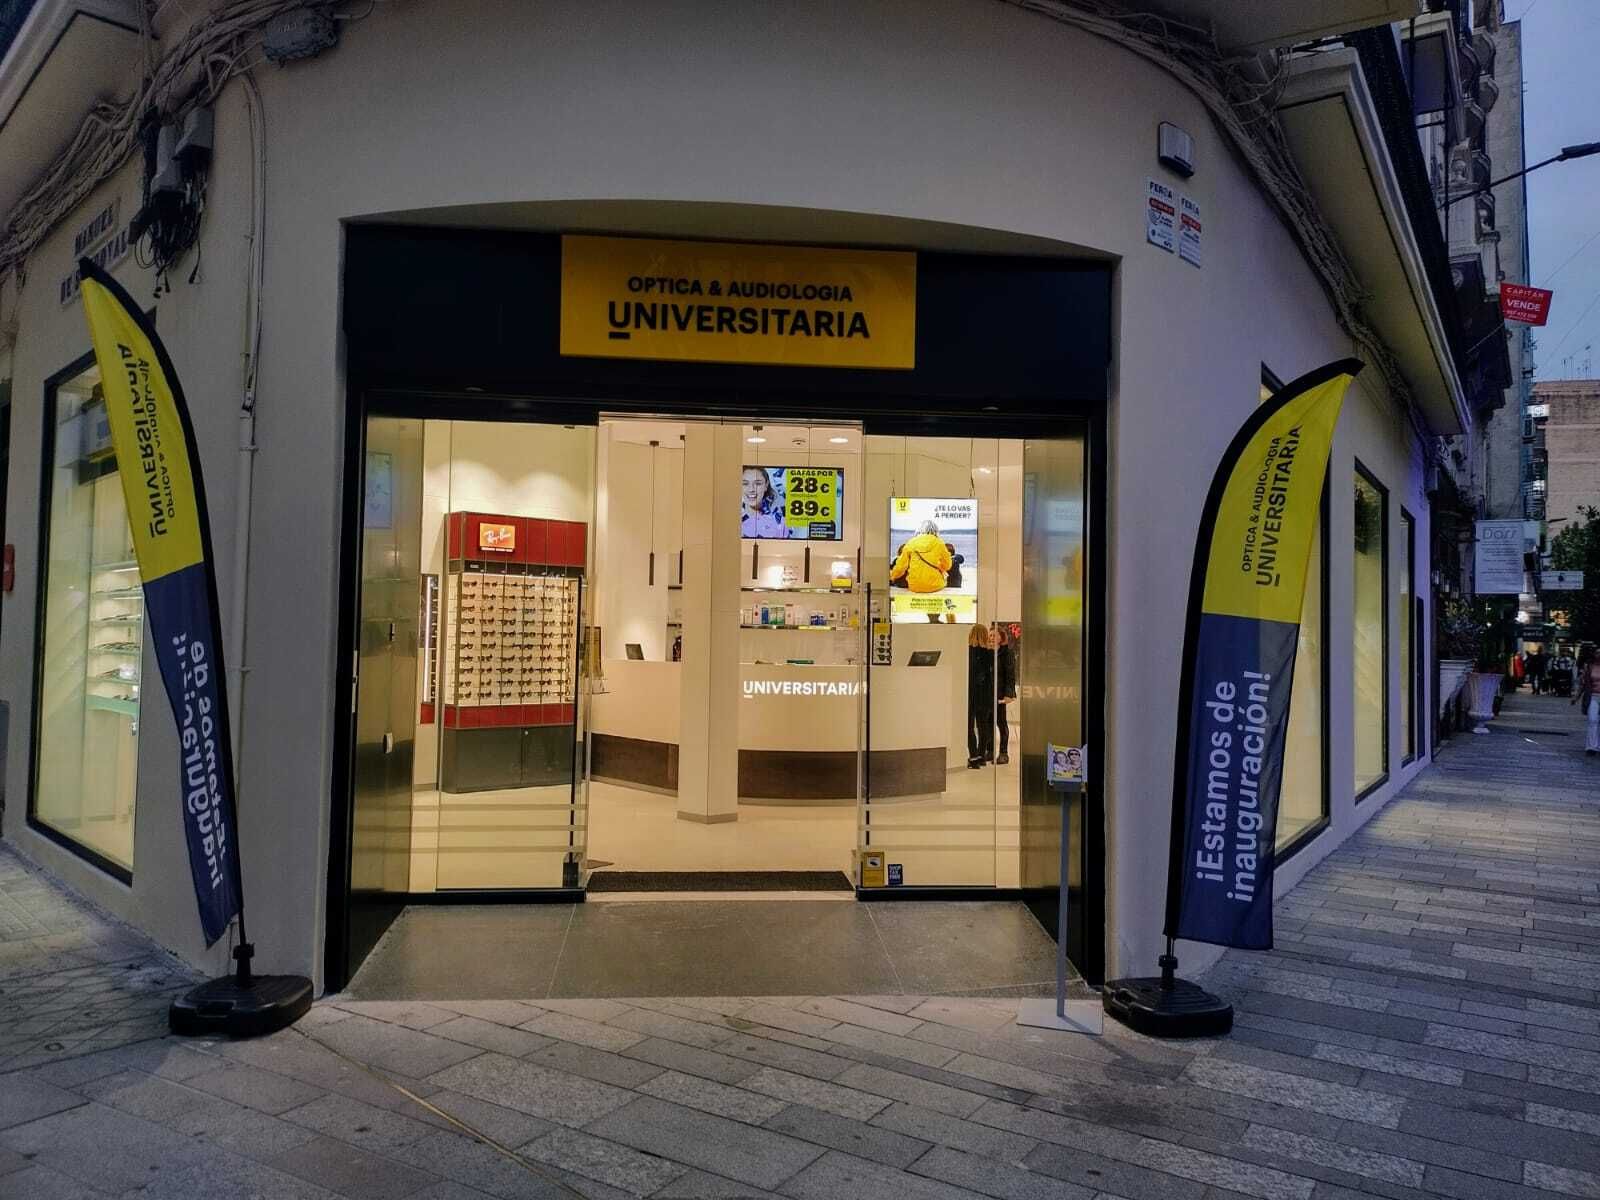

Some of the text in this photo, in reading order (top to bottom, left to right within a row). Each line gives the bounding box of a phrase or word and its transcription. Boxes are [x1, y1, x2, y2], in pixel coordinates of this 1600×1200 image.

[628, 276, 853, 302] OPTICA & AUDIOLOGIA
[1506, 299, 1541, 312] VENDE
[608, 300, 871, 340] UNIVERSITARIA
[790, 477, 818, 493] 28
[1241, 437, 1281, 572] OPTICA & AUDIOLOGIA
[790, 500, 819, 516] 89
[1256, 425, 1303, 586] UNIVERSITARIA
[1196, 680, 1236, 882] ¡Estamos de
[1226, 671, 1271, 902] inauguración!
